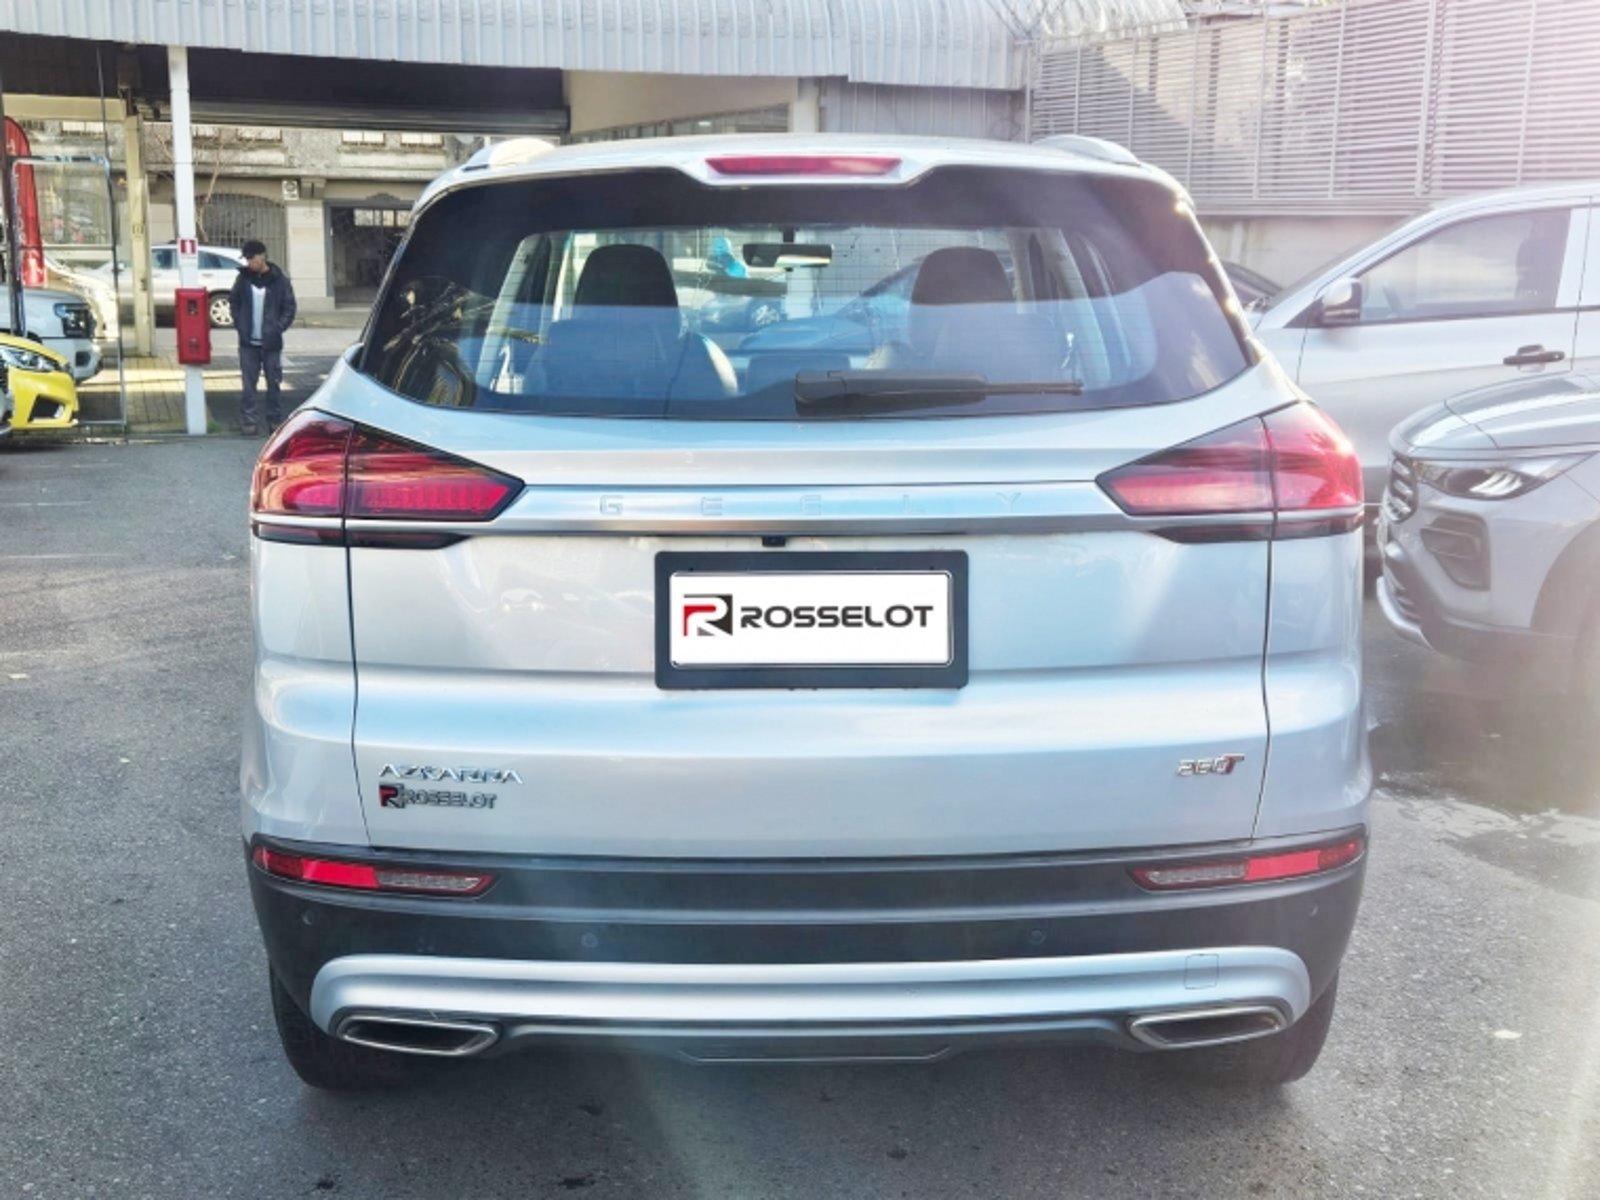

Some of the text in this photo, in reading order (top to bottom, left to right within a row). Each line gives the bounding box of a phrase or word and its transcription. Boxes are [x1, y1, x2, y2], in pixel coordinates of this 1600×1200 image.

[599, 492, 1022, 517] GEELY
[740, 604, 934, 628] ROSSELOT
[378, 763, 524, 785] AZKARRA
